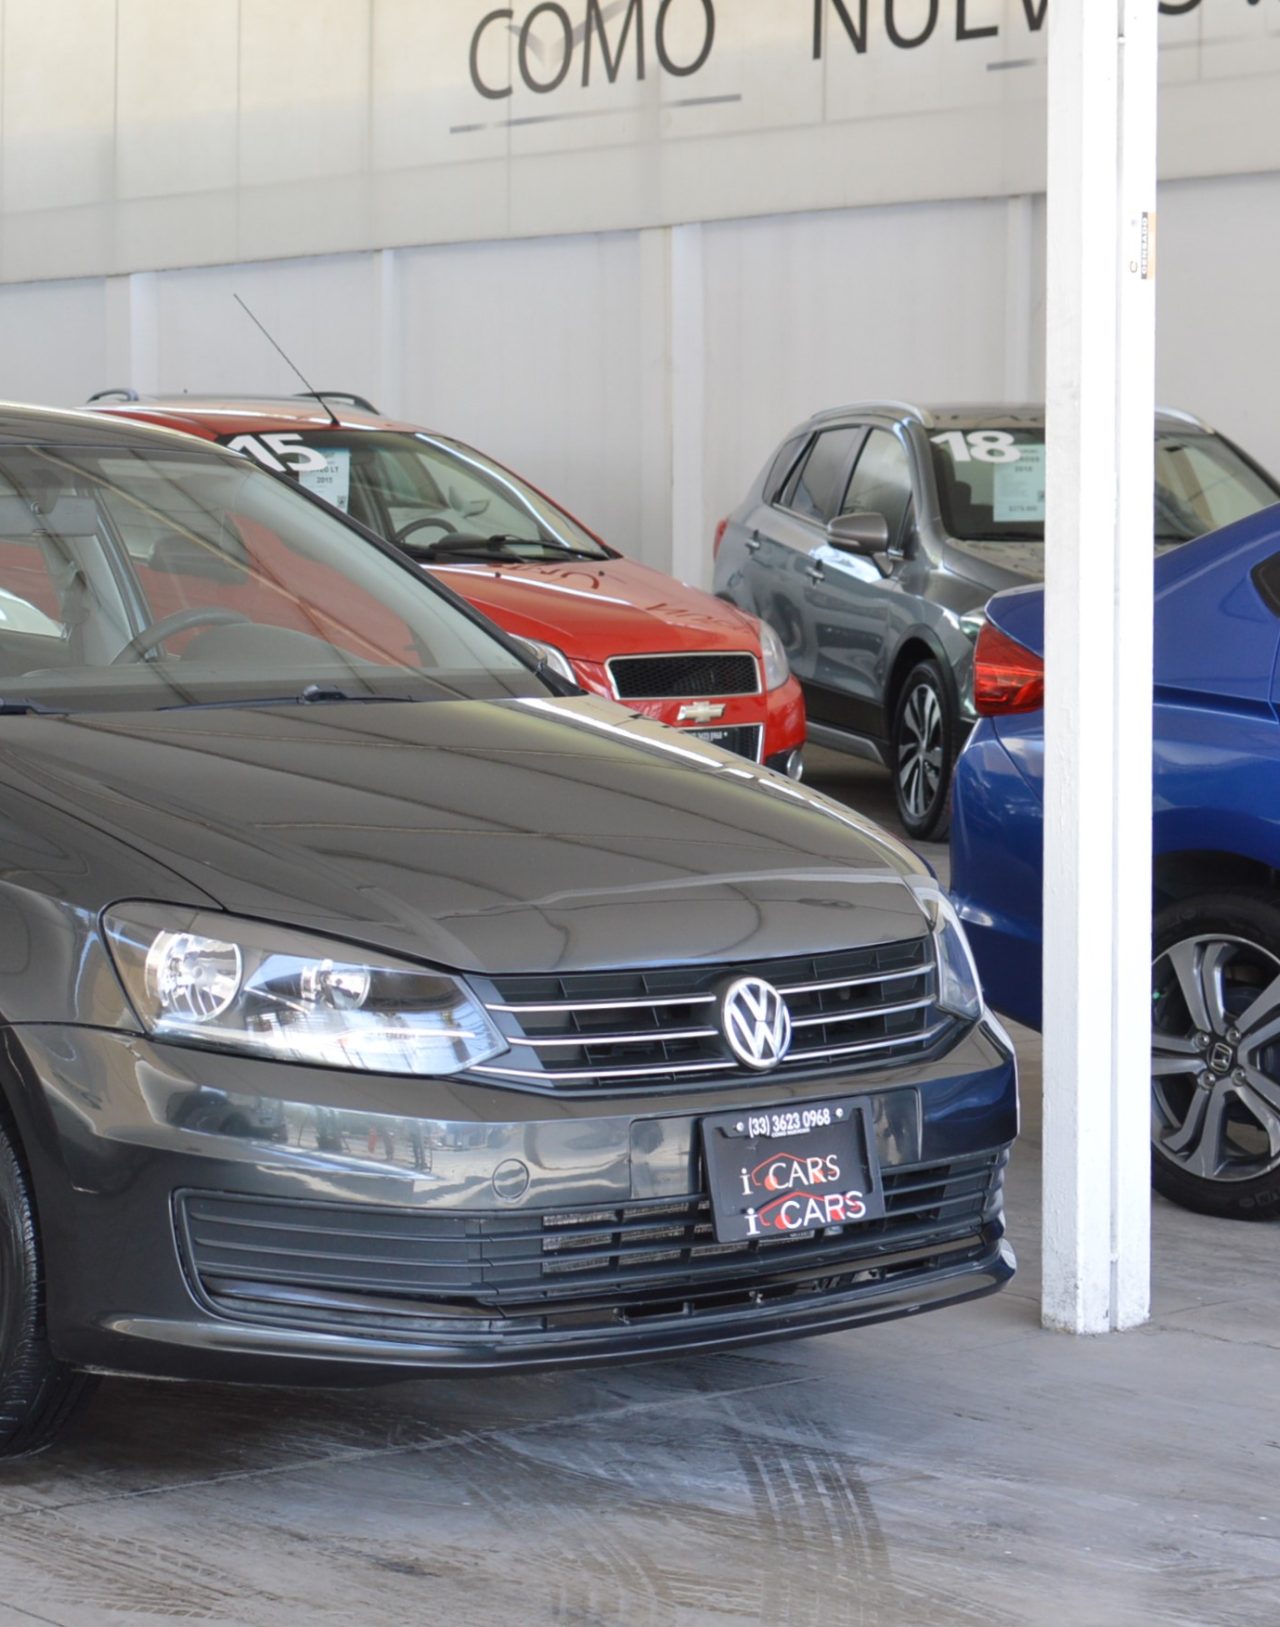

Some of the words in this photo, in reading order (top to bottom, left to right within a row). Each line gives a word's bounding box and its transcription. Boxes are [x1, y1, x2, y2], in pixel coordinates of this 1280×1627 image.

[469, 0, 715, 99] COMO
[227, 433, 327, 472] 15
[929, 430, 1021, 463] 18
[748, 1116, 770, 1138] (33)
[772, 1112, 801, 1132] 3623
[802, 1108, 831, 1127] 0968
[740, 1168, 753, 1195] i
[769, 1154, 840, 1189] CARS
[744, 1208, 760, 1235] i
[780, 1191, 866, 1229] CARS
